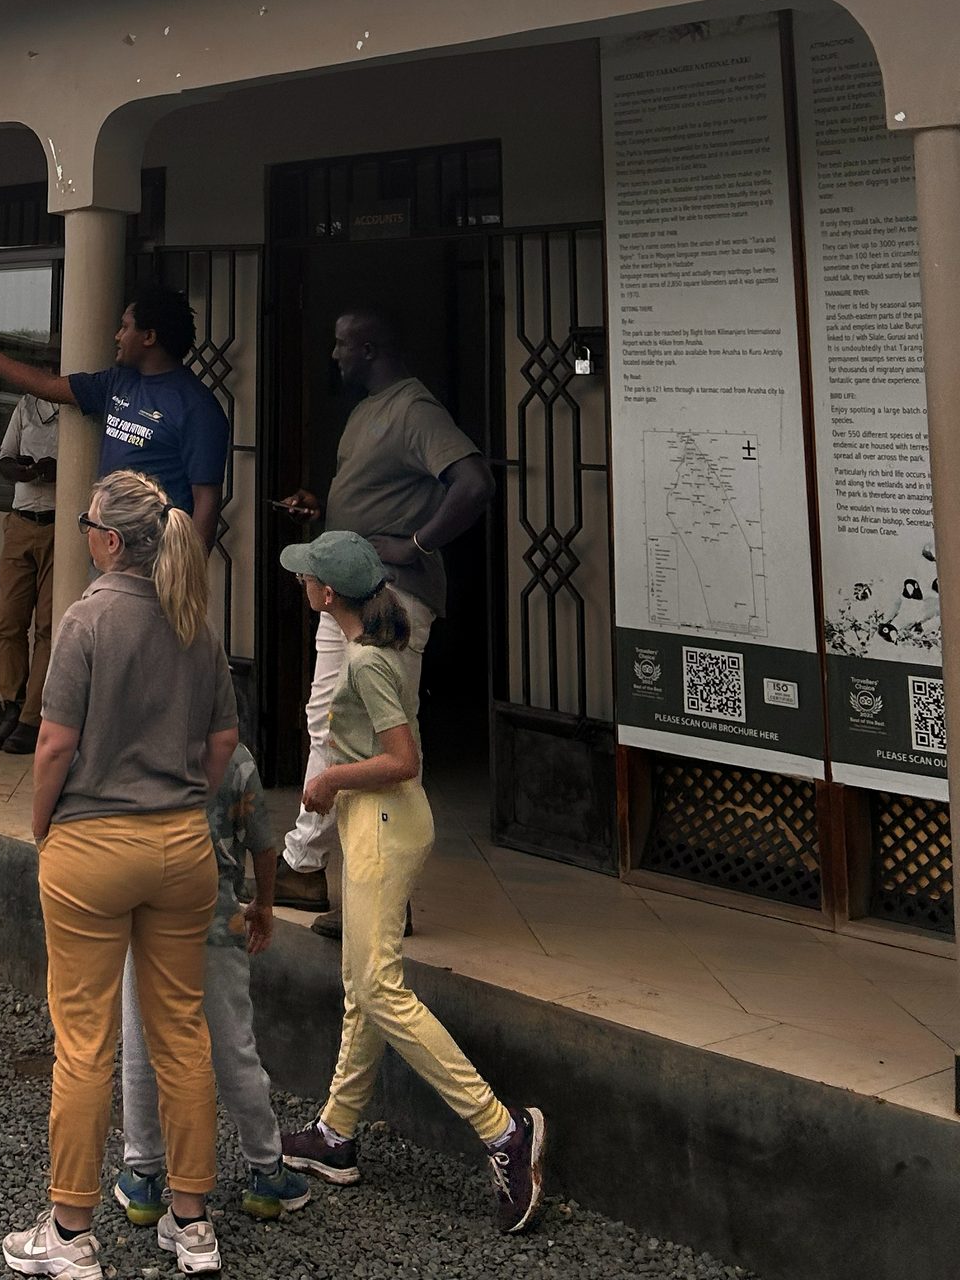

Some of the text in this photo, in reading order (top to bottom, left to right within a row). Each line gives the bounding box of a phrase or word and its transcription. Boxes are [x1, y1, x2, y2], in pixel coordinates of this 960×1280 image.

[353, 213, 404, 226] ACCOUNTS
[825, 302, 836, 310] The
[880, 301, 907, 309] seasonal
[632, 330, 643, 338] park
[634, 385, 645, 394] park
[831, 405, 848, 414] Enjoy
[849, 405, 876, 415] spotting
[883, 406, 901, 416] large
[832, 429, 847, 437] Over
[848, 430, 861, 438] 550
[889, 431, 914, 441] species
[128, 434, 144, 447] 2024
[871, 442, 894, 450] housed
[833, 452, 854, 461] spread
[834, 467, 867, 478] Particularly
[868, 469, 880, 477] rich
[881, 469, 894, 477] bird
[835, 478, 847, 486] and
[847, 479, 865, 488] along
[905, 481, 917, 489] and
[836, 503, 849, 511] One
[837, 514, 851, 522] such
[861, 516, 882, 524] African
[847, 525, 859, 534] and
[773, 683, 789, 692] ISO
[654, 712, 779, 741] PLEASE SCAN OUR BROCHURE HERE
[876, 749, 947, 768] PLEASE SCAN OU
